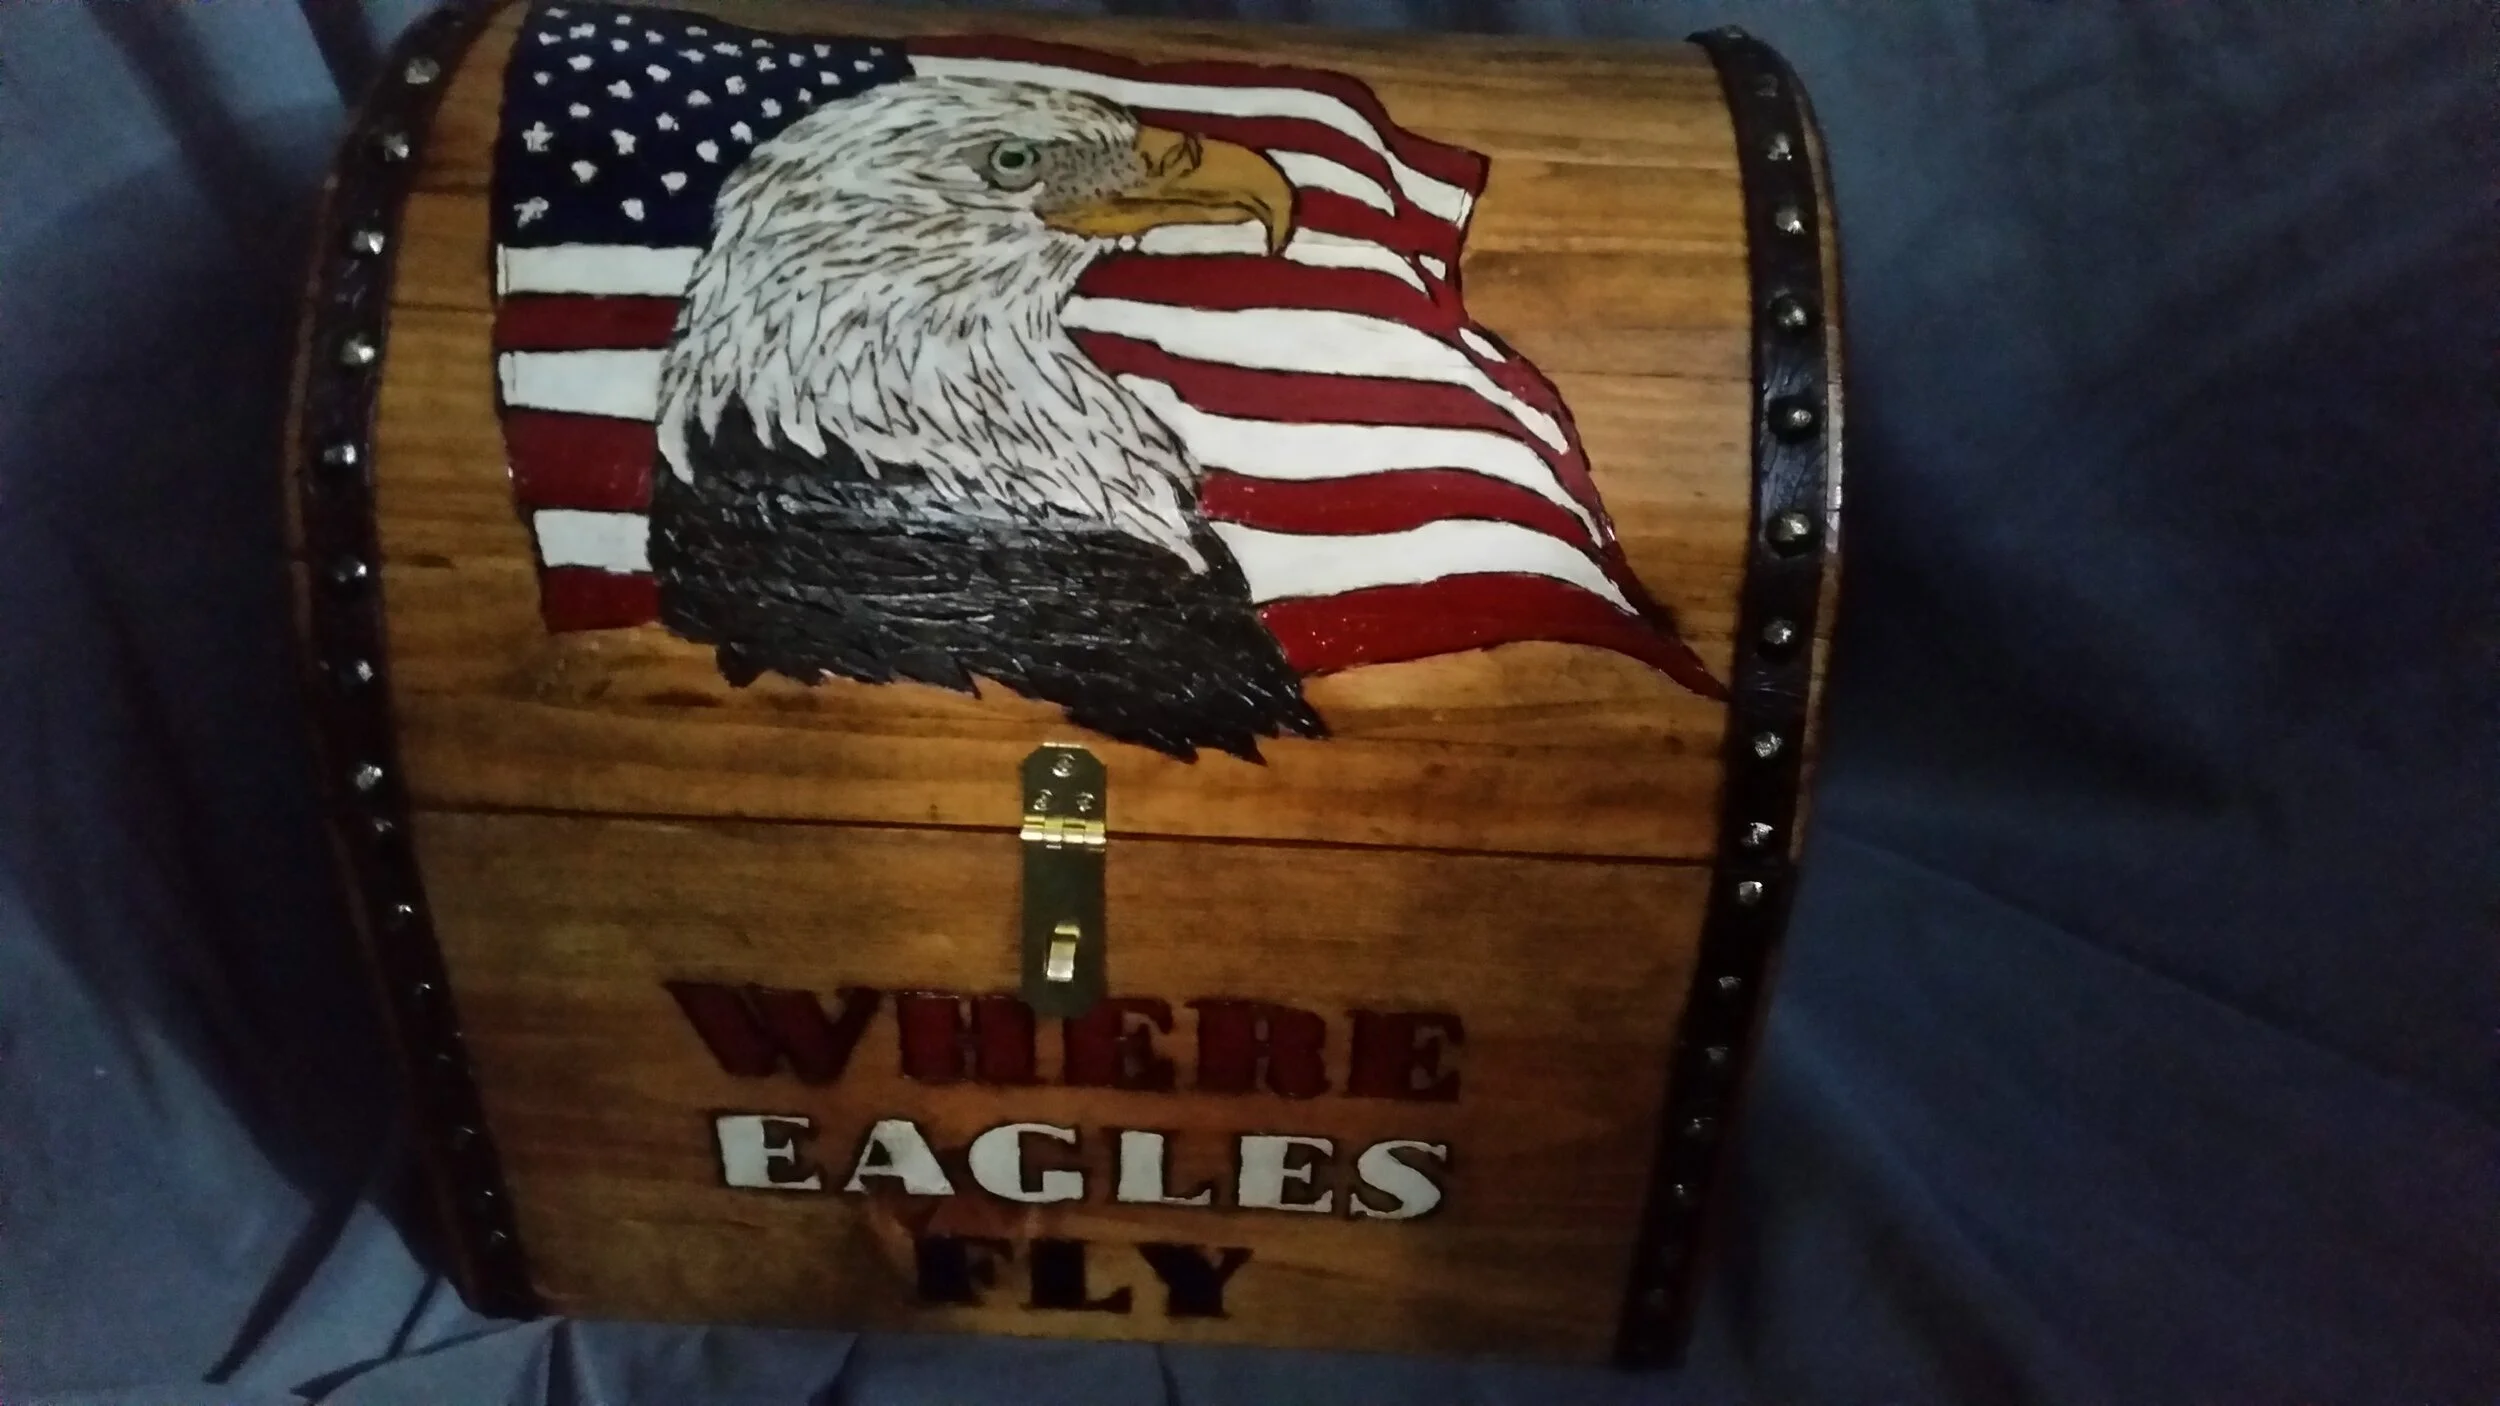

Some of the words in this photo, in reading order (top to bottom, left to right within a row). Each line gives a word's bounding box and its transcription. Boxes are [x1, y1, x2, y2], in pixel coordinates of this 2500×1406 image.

[663, 980, 1464, 1102] WHERE
[714, 1113, 1449, 1220] EAGLES
[914, 1235, 1254, 1318] FLY
